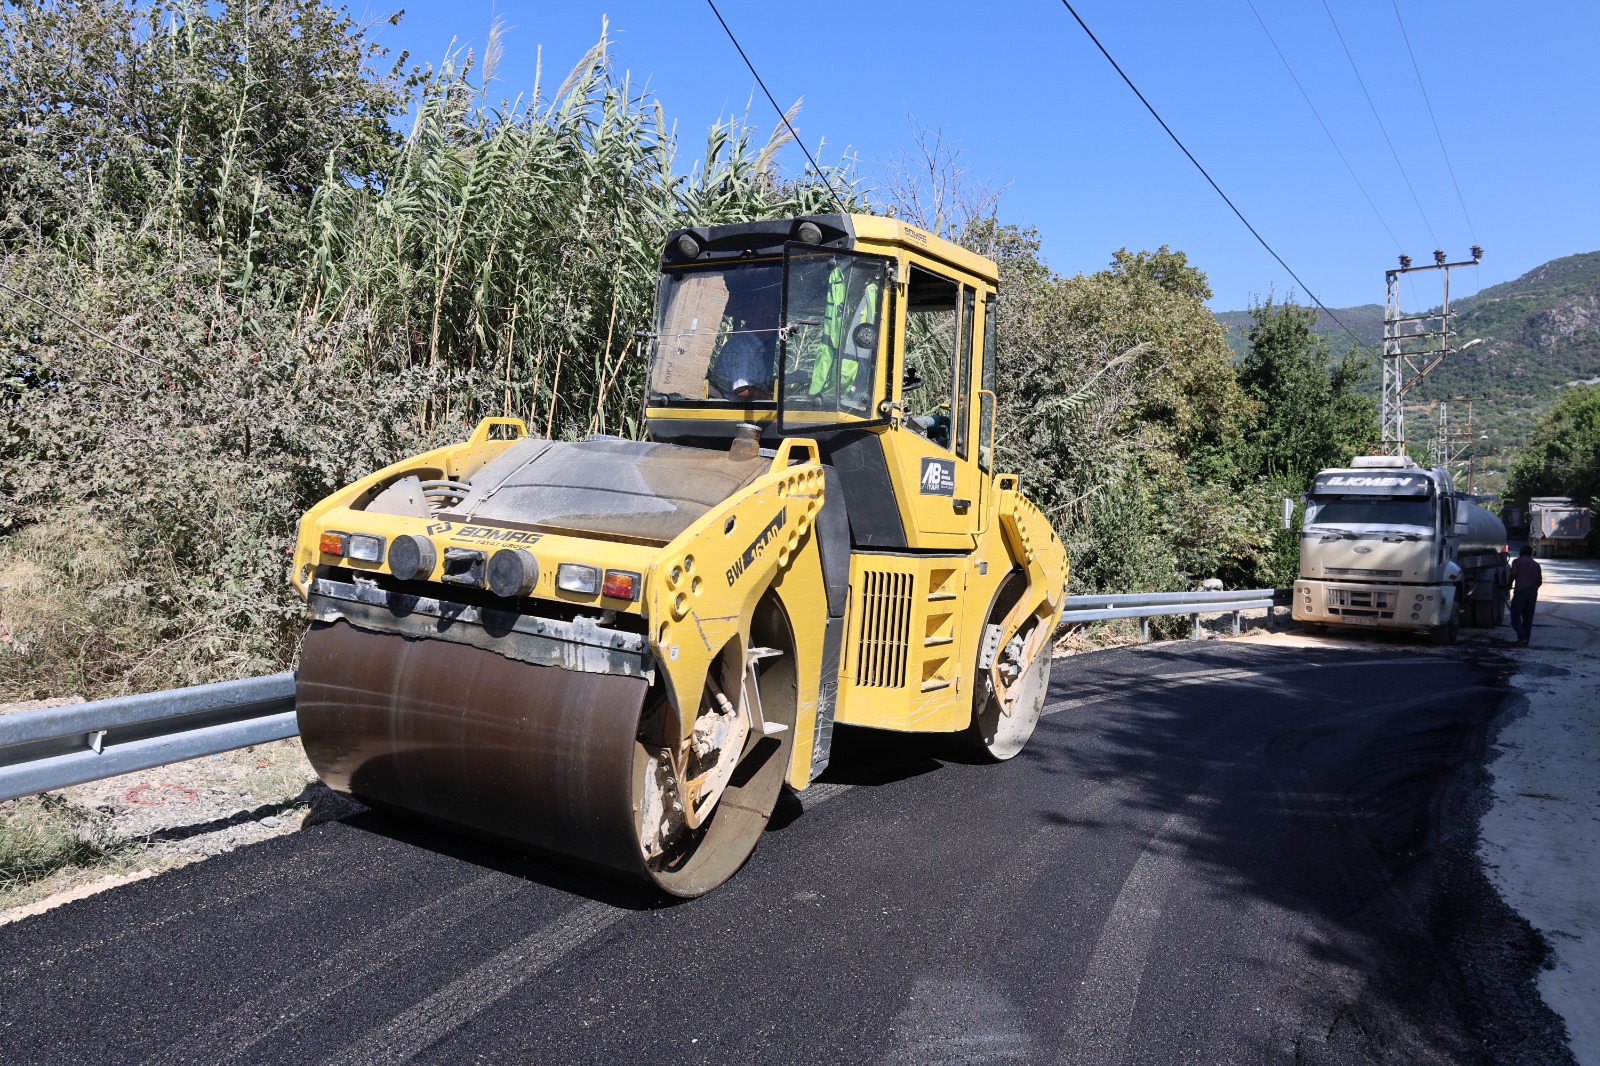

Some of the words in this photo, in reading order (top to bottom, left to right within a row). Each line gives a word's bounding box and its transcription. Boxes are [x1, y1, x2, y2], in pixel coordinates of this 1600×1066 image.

[456, 526, 544, 545] BOMAG
[476, 539, 500, 547] FAYAT
[501, 542, 532, 551] GROUP
[725, 557, 744, 588] BW
